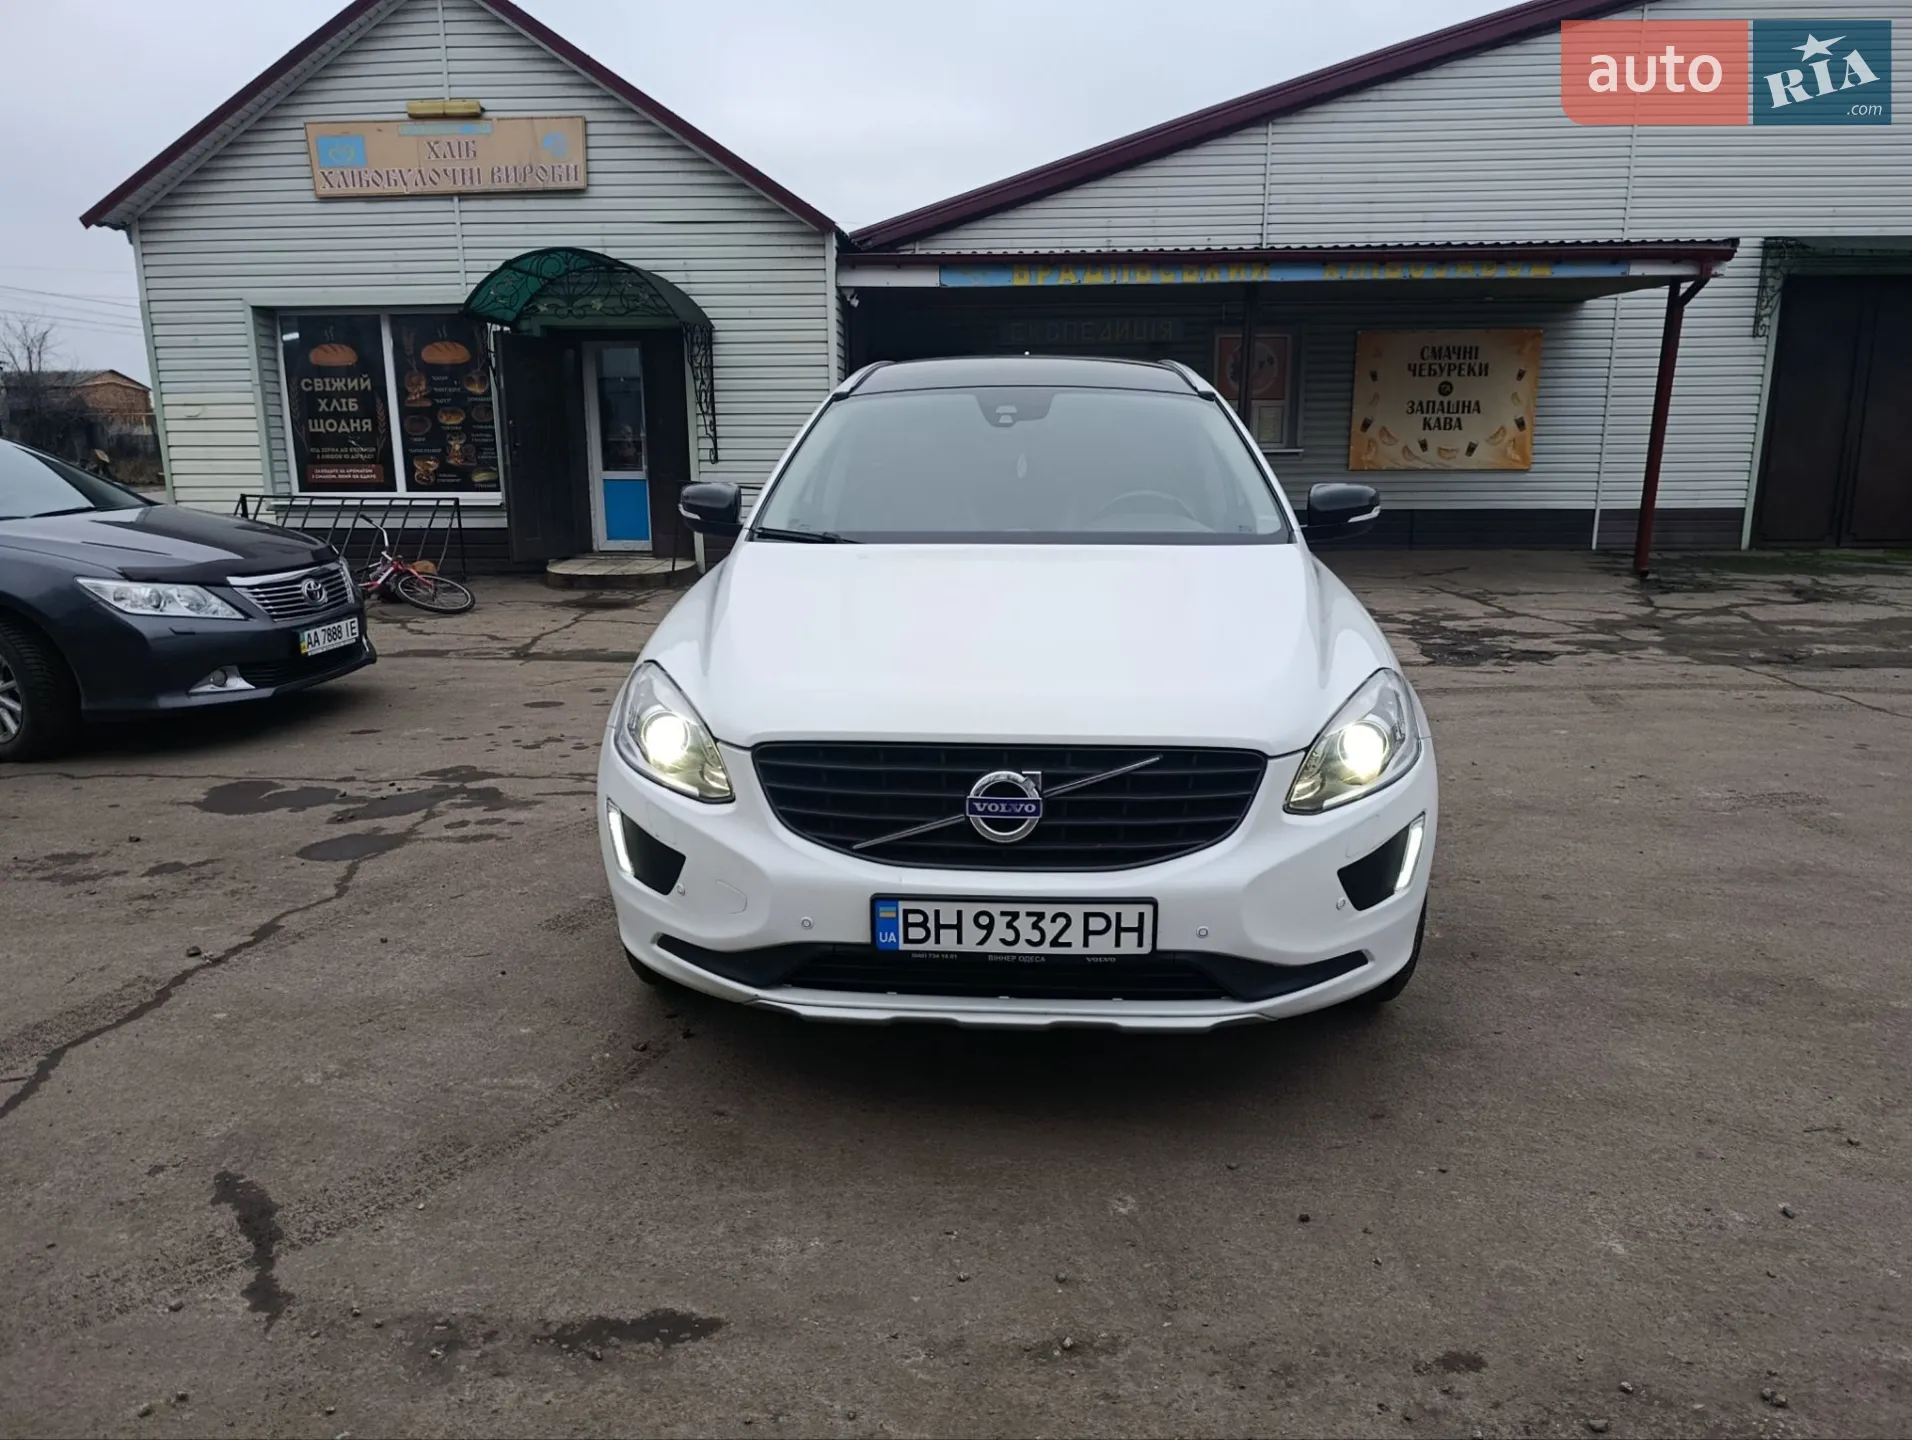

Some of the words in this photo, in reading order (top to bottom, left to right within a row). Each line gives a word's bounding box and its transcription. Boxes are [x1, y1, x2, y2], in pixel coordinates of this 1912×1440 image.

[426, 139, 477, 160] ХЛІБ
[319, 166, 483, 193] ХЛІБОБУЛОЧНІ
[490, 163, 581, 185] ВИРОБИ
[1420, 345, 1479, 361] СМАЧНІ
[1407, 362, 1489, 377] ЧЕБУРЕКИ
[301, 374, 372, 392] СВІЖИЙ
[318, 398, 359, 412] ХЛІБ
[1406, 400, 1481, 415] ЗАПАШНА
[308, 418, 373, 434] ЩОДНЯ
[1422, 416, 1463, 431] КАВА
[307, 630, 320, 649] AA
[346, 620, 357, 638] IE
[973, 802, 1037, 813] VOLVO
[902, 908, 963, 945] BH
[972, 909, 1073, 948] 9332
[1082, 911, 1145, 948] PH
[879, 931, 897, 943] UA
[1018, 955, 1046, 963] ОДЕСА
